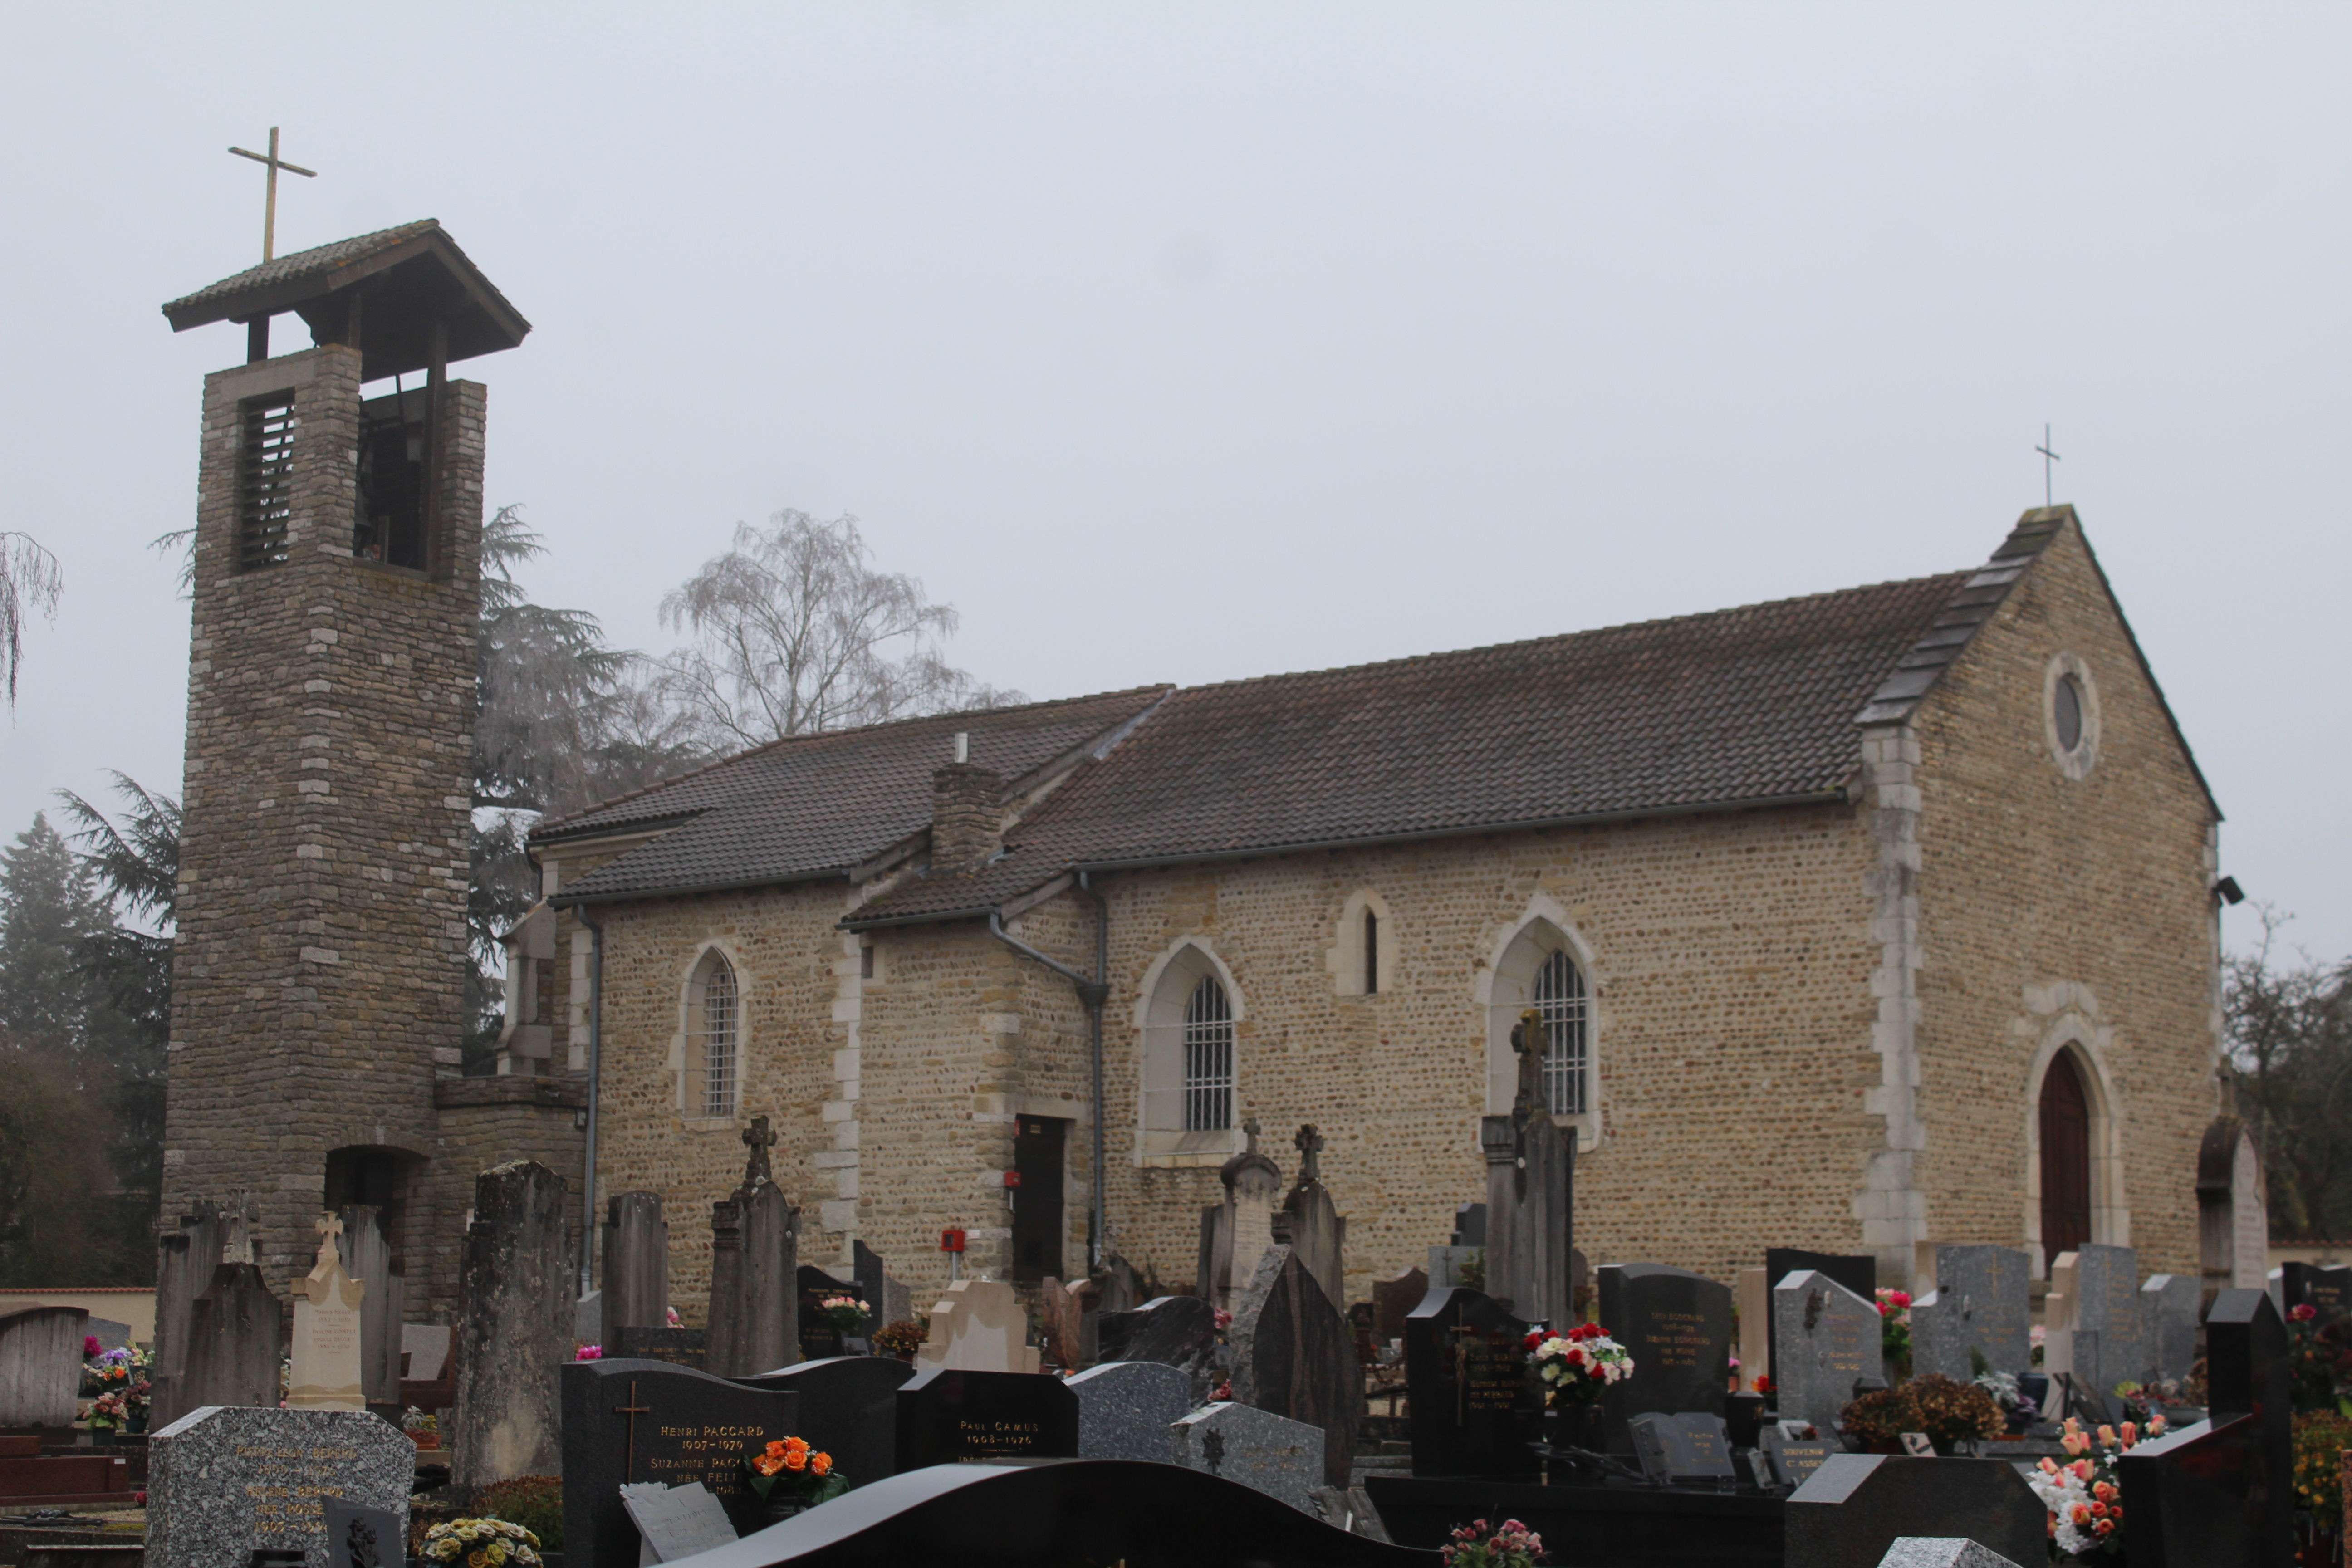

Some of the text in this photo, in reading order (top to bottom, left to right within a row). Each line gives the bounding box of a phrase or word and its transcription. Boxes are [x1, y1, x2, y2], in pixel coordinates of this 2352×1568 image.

[661, 1426, 764, 1436] HENRI PACCARD
[960, 1421, 1039, 1432] PAUL CAMUS
[650, 1458, 705, 1469] SUZANNE
[707, 1473, 736, 1483] FELI
